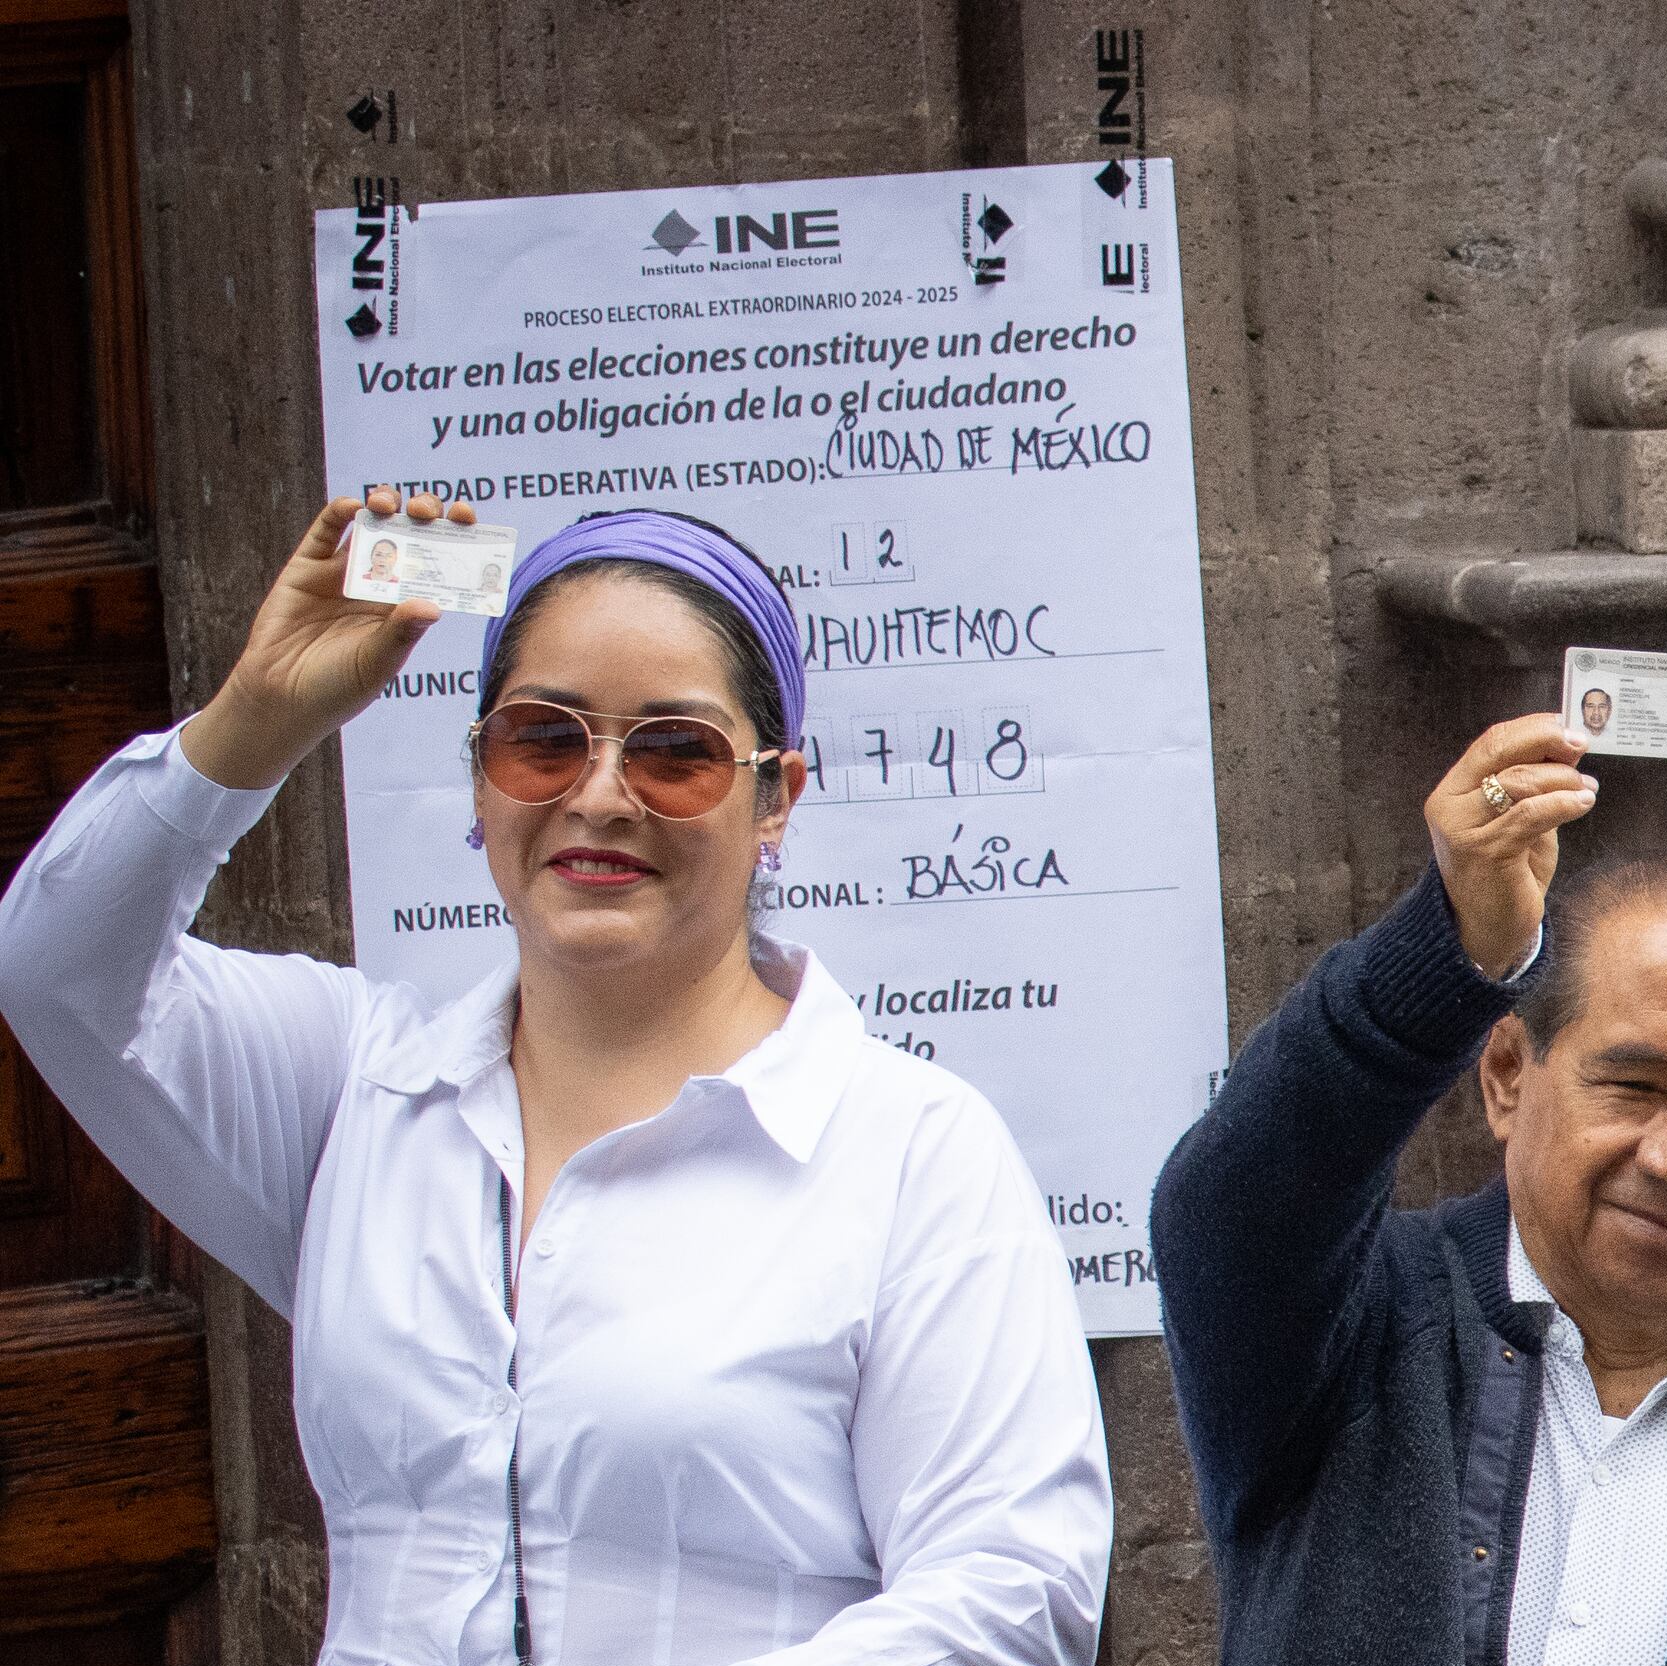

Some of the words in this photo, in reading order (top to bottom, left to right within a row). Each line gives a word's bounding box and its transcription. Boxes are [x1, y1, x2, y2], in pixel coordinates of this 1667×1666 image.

[1096, 29, 1131, 144] INE
[353, 177, 385, 289] INE
[641, 263, 705, 277] Instituto
[709, 258, 772, 272] Nacional
[776, 253, 843, 268] Electoral
[715, 209, 841, 254] INE
[524, 308, 603, 329] PROCESO
[607, 302, 705, 324] ELECTORAL
[708, 292, 857, 317] EXTRAORDINARIO
[861, 288, 902, 309] 2024
[916, 286, 959, 305] 2025
[358, 361, 457, 394] Votar
[464, 361, 504, 388] en
[512, 351, 561, 385] las
[568, 343, 747, 381] elecciones
[754, 331, 929, 371] constituye
[938, 332, 981, 357] un
[990, 315, 1137, 354] derecho
[431, 414, 453, 449] y
[460, 410, 526, 438] una
[534, 391, 716, 438] obligación
[724, 388, 766, 419] de
[773, 386, 802, 418] la
[810, 393, 833, 415] o
[840, 380, 870, 414] el
[877, 372, 1067, 413] ciudadano
[826, 410, 944, 480] CIUDAD
[958, 426, 994, 470] DE
[1011, 403, 1152, 475] MÉXICO
[503, 464, 678, 499] FEDERATIVA
[685, 456, 826, 491] (ESTADO):
[864, 728, 894, 785] 7
[928, 726, 957, 797] 4
[986, 718, 1028, 781] 8
[874, 979, 1013, 1017] localiza
[1022, 981, 1059, 1009] tu
